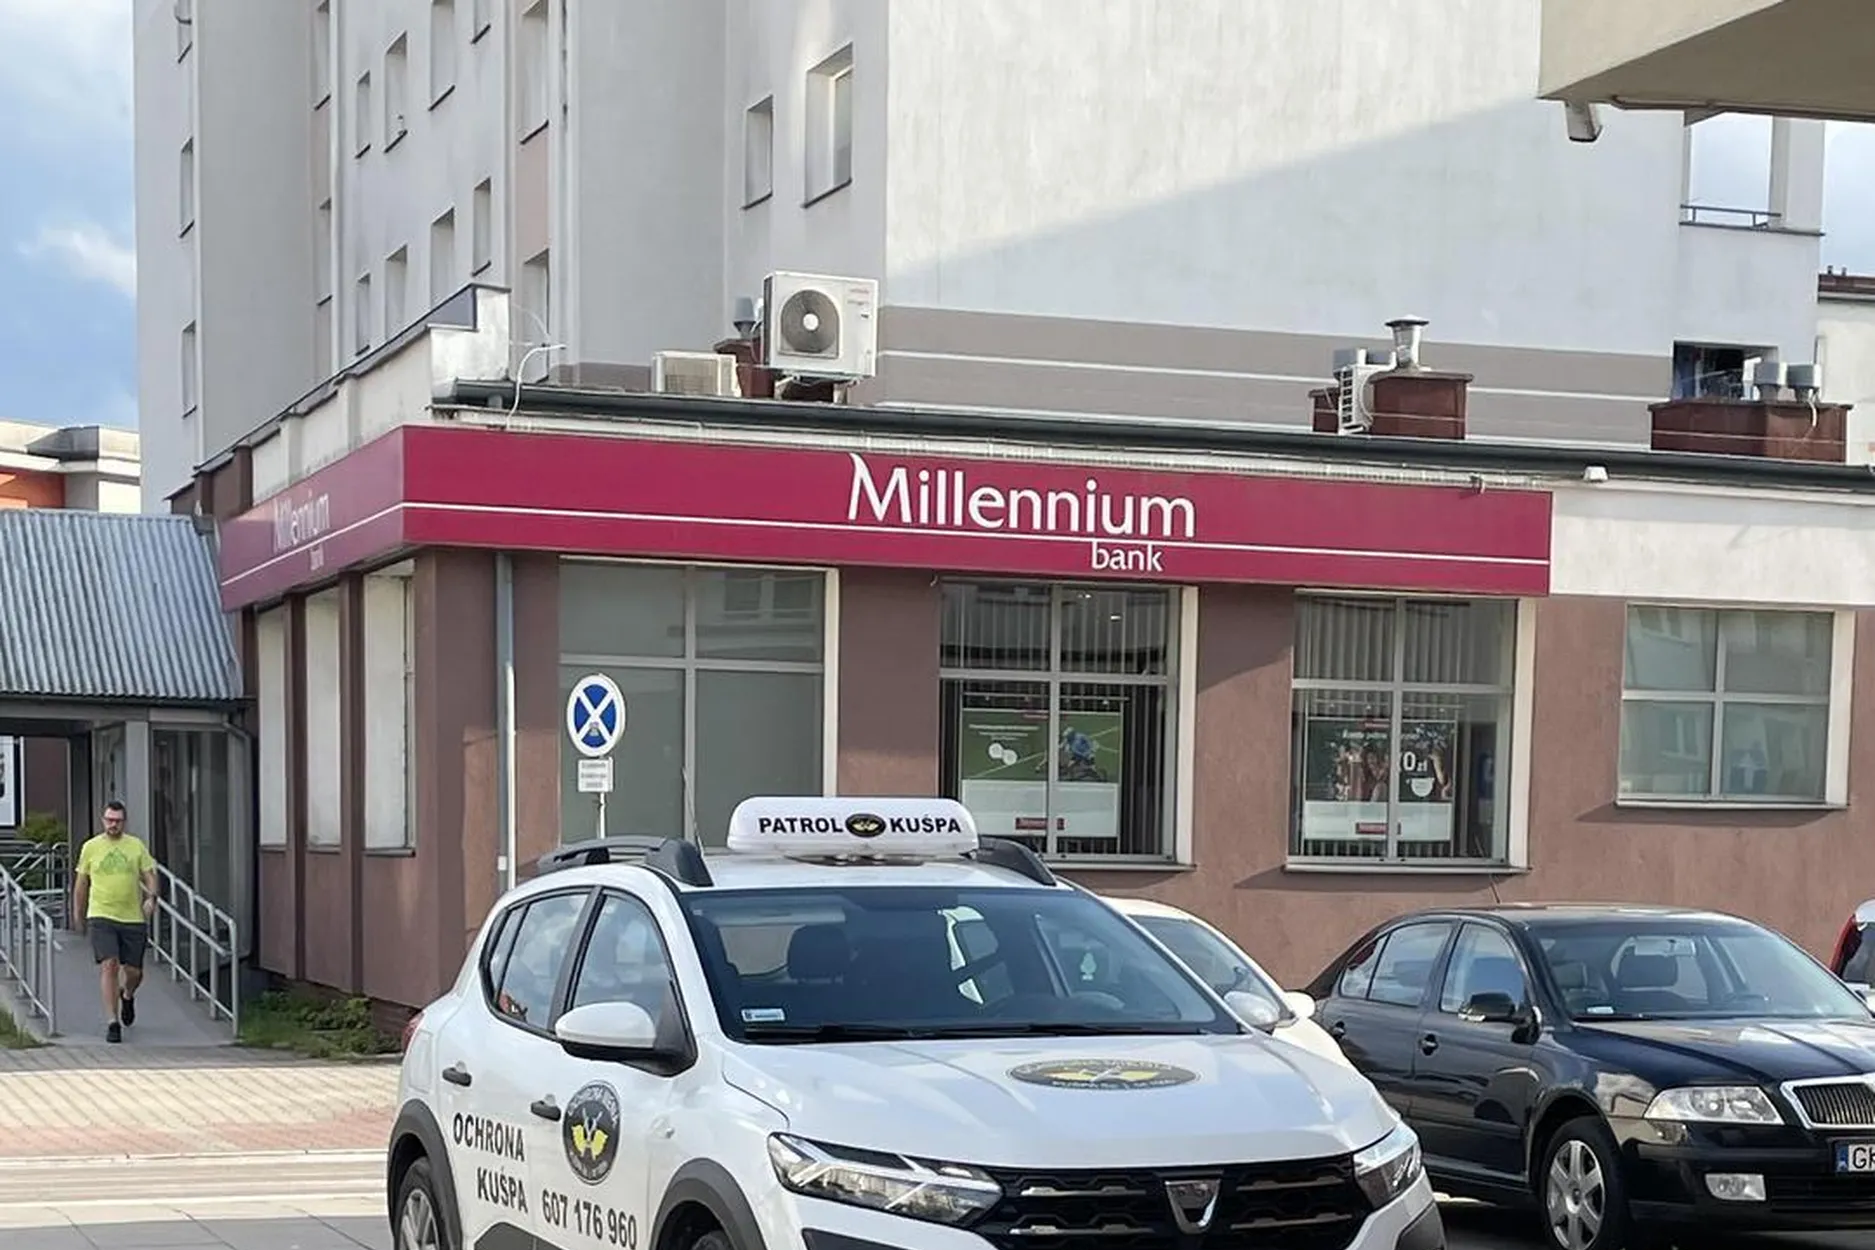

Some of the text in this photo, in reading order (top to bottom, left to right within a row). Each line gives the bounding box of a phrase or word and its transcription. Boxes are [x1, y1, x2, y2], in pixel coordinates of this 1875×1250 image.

[848, 452, 1195, 538] Millennium
[1090, 541, 1164, 572] bank
[758, 814, 962, 834] PATROL KUŚPA
[453, 1112, 525, 1163] OCHRONA
[477, 1165, 529, 1214] KUŚPA
[542, 1188, 637, 1250] 607 176 960
